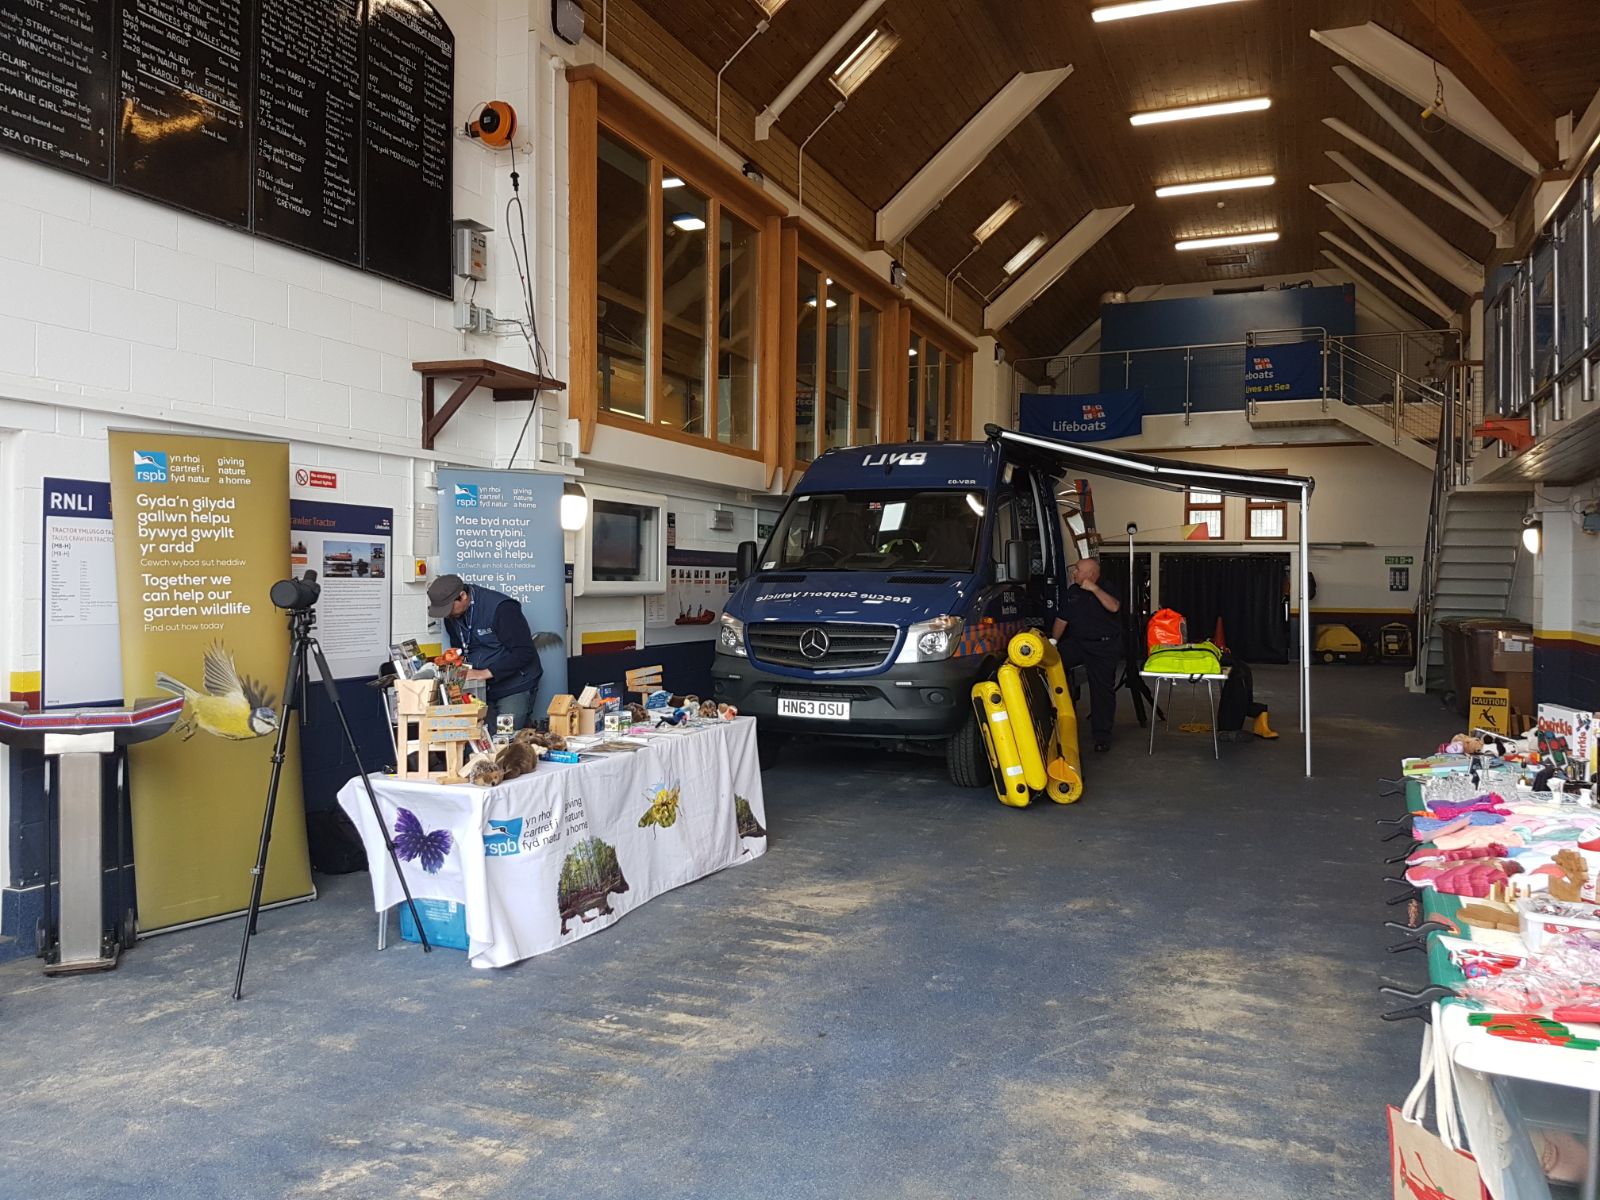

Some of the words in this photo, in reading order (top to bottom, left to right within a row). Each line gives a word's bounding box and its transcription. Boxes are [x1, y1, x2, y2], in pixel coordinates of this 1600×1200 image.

[1052, 421, 1106, 432] Lifeboats
[170, 455, 181, 464] yn
[183, 454, 200, 463] rhoi
[218, 457, 244, 468] giving
[137, 470, 166, 482] rspb
[170, 475, 185, 484] fyd
[50, 492, 92, 511] RNLI
[192, 498, 236, 512] gilydd
[456, 498, 477, 507] rspb
[138, 510, 187, 526] gallwn
[191, 511, 230, 526] helpu
[456, 516, 478, 524] Mae
[480, 516, 500, 527] byd
[502, 518, 530, 526] natur
[138, 526, 187, 540] bywyd
[191, 527, 234, 542] gwyllt
[490, 528, 526, 538] trybini.
[140, 543, 155, 556] yr
[160, 542, 194, 552] ardd
[495, 539, 526, 550] gilydd
[457, 550, 492, 561] gallwn
[506, 550, 534, 560] helpu
[142, 574, 207, 590] Together
[210, 576, 231, 585] we
[457, 573, 494, 582] Nature
[496, 573, 504, 581] is
[506, 573, 516, 581] in
[500, 583, 544, 594] Together
[142, 592, 170, 602] can
[174, 590, 204, 603] help
[208, 590, 232, 600] our
[522, 594, 531, 602] it.
[144, 605, 197, 622] garden
[200, 603, 251, 615] wildlife
[200, 622, 224, 631] today
[783, 700, 814, 714] HN63
[818, 703, 844, 716] OSU
[1539, 716, 1572, 736] Qwirkle
[526, 818, 536, 827] yn
[538, 808, 552, 819] rhoi
[565, 810, 584, 822] nature
[524, 821, 553, 838] cartref
[570, 822, 588, 833] home
[484, 838, 516, 856] rspb
[522, 840, 540, 850] fyd
[543, 832, 561, 844] natur
